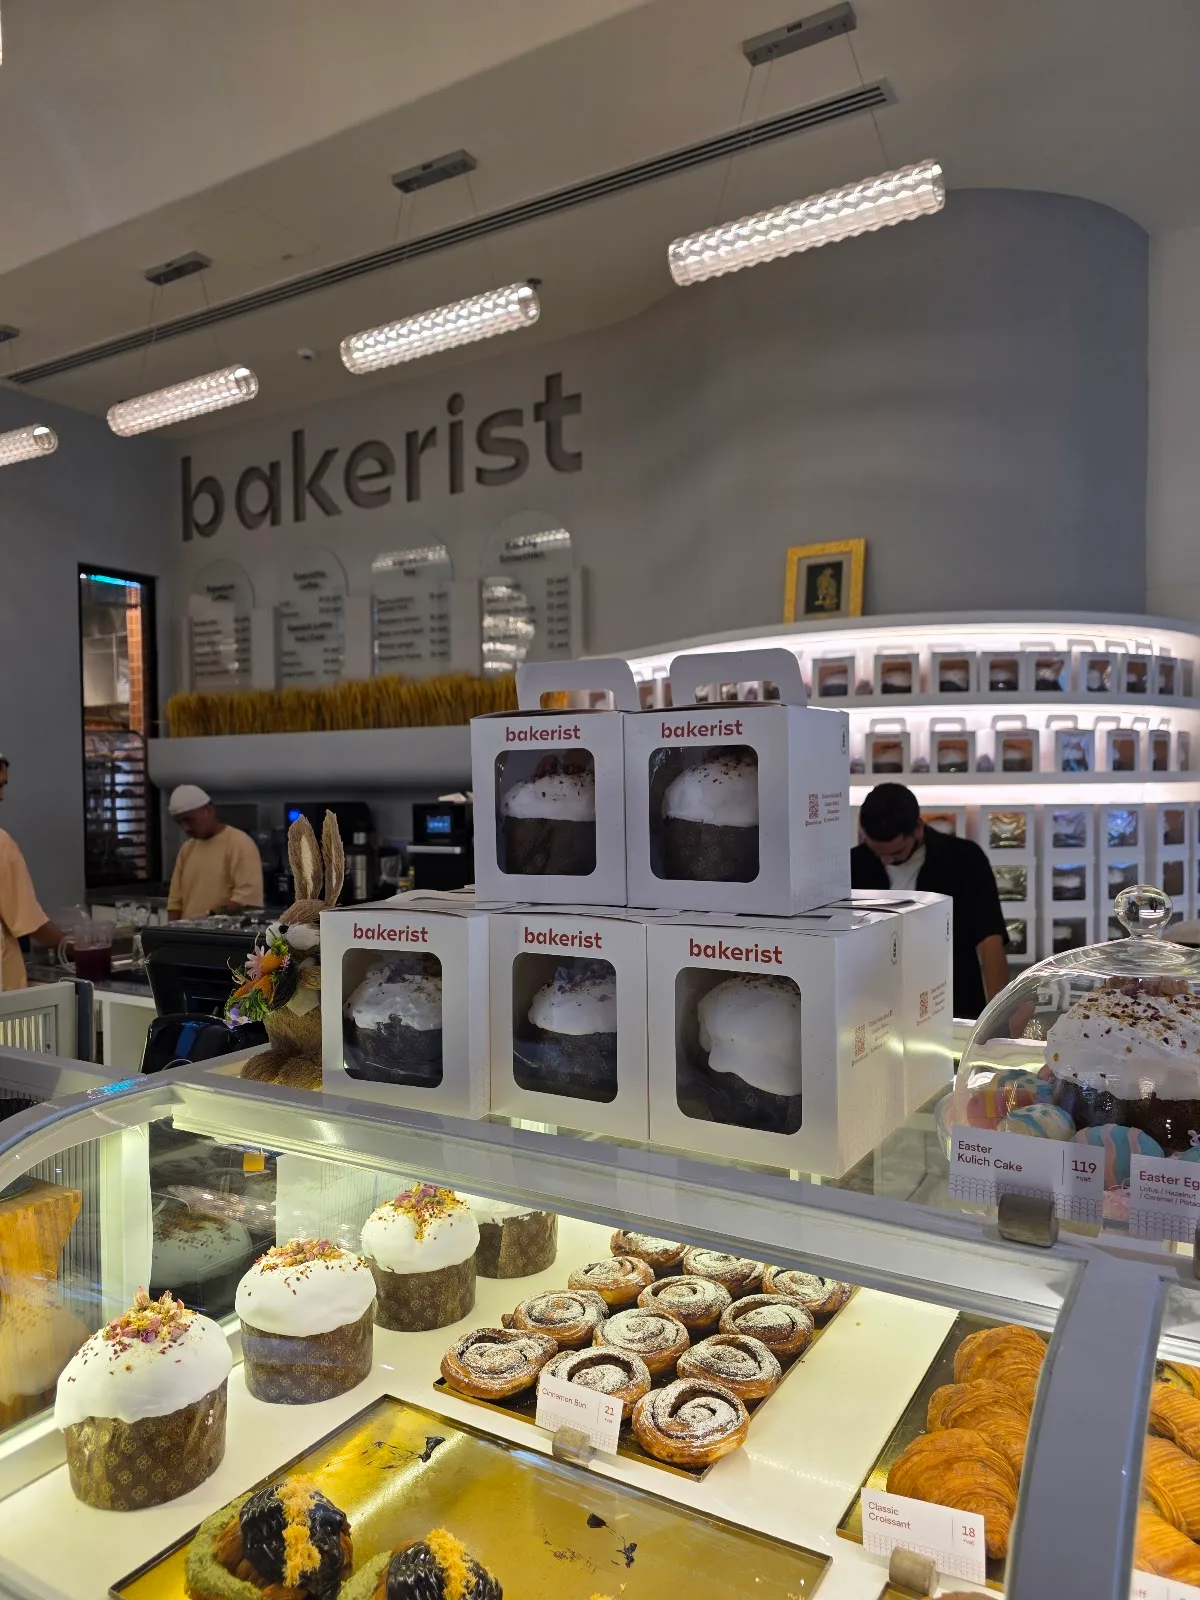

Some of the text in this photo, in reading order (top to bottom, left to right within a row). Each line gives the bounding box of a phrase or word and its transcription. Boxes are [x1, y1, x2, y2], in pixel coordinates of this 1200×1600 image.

[181, 371, 583, 542] bakerist
[505, 724, 581, 742] bakerist
[661, 719, 743, 739] bakerist
[353, 922, 428, 943] bakerist
[524, 926, 603, 949] bakerist
[689, 938, 783, 965] bakerist
[958, 1140, 993, 1154] Easter
[957, 1152, 1023, 1172] Kulich Cake
[1071, 1160, 1097, 1174] 119
[1139, 1170, 1180, 1186] Easter
[1139, 1186, 1159, 1194] Lotus
[1165, 1189, 1197, 1200] Hazelnut
[1144, 1193, 1174, 1203] Caramel
[541, 1387, 587, 1409] Cinnamon Bun
[604, 1405, 615, 1416] 21
[868, 1501, 899, 1516] Classic
[868, 1512, 911, 1530] Croissant
[961, 1525, 976, 1538] 18
